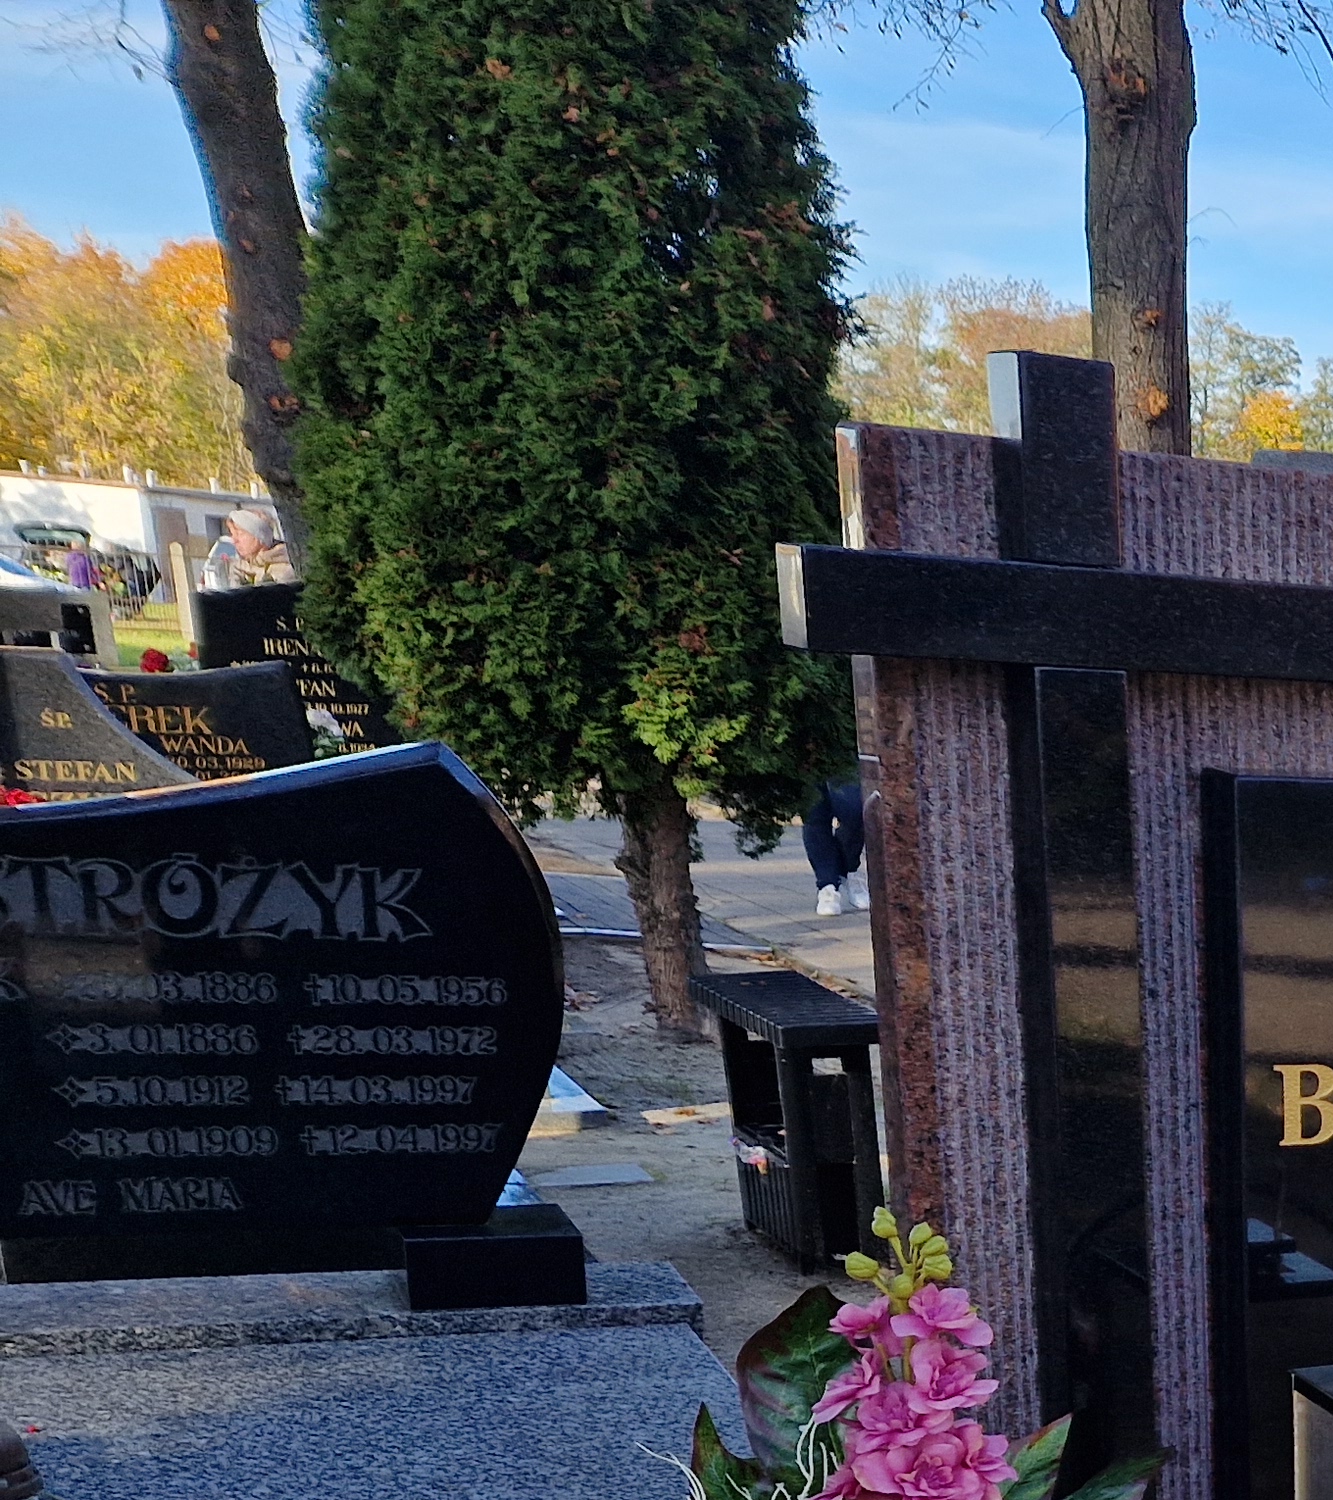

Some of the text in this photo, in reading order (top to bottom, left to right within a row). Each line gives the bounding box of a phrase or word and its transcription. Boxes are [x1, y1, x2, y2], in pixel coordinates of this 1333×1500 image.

[262, 636, 323, 657] IREN
[102, 704, 213, 736] REK
[158, 734, 250, 757] WANDA
[14, 758, 138, 784] STEFAN
[0, 852, 433, 940] TRÓŻYK
[17, 1175, 245, 1215] AVE MARIA
